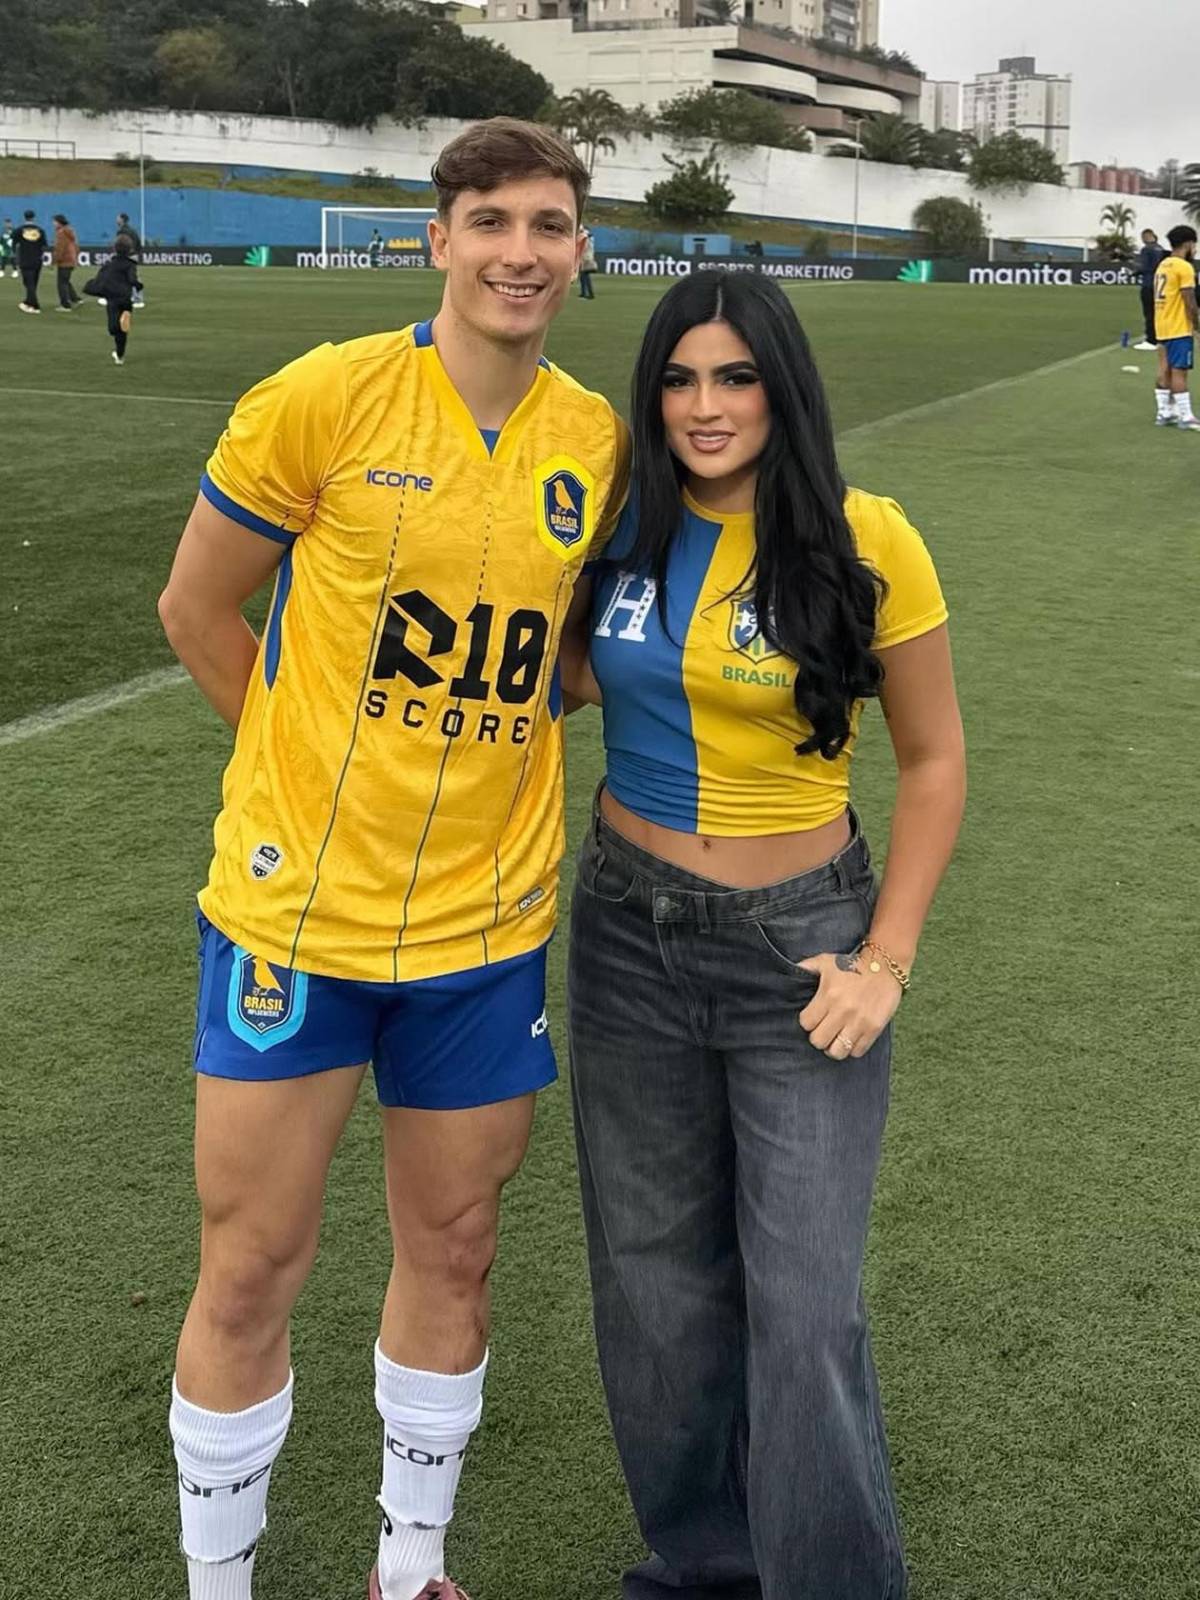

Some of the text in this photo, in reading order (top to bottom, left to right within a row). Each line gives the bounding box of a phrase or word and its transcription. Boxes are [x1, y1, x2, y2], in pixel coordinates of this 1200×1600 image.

[142, 252, 213, 265] MARKETING
[297, 248, 372, 268] manita
[377, 255, 426, 267] SPORTS
[606, 255, 692, 276] manita
[761, 264, 854, 279] MARKETING
[969, 263, 1073, 285] manita
[550, 514, 579, 529] BRASIL
[594, 571, 657, 642] H
[721, 665, 792, 688] BRASIL
[364, 690, 531, 744] SCORE
[244, 995, 284, 1011] BRASIL
